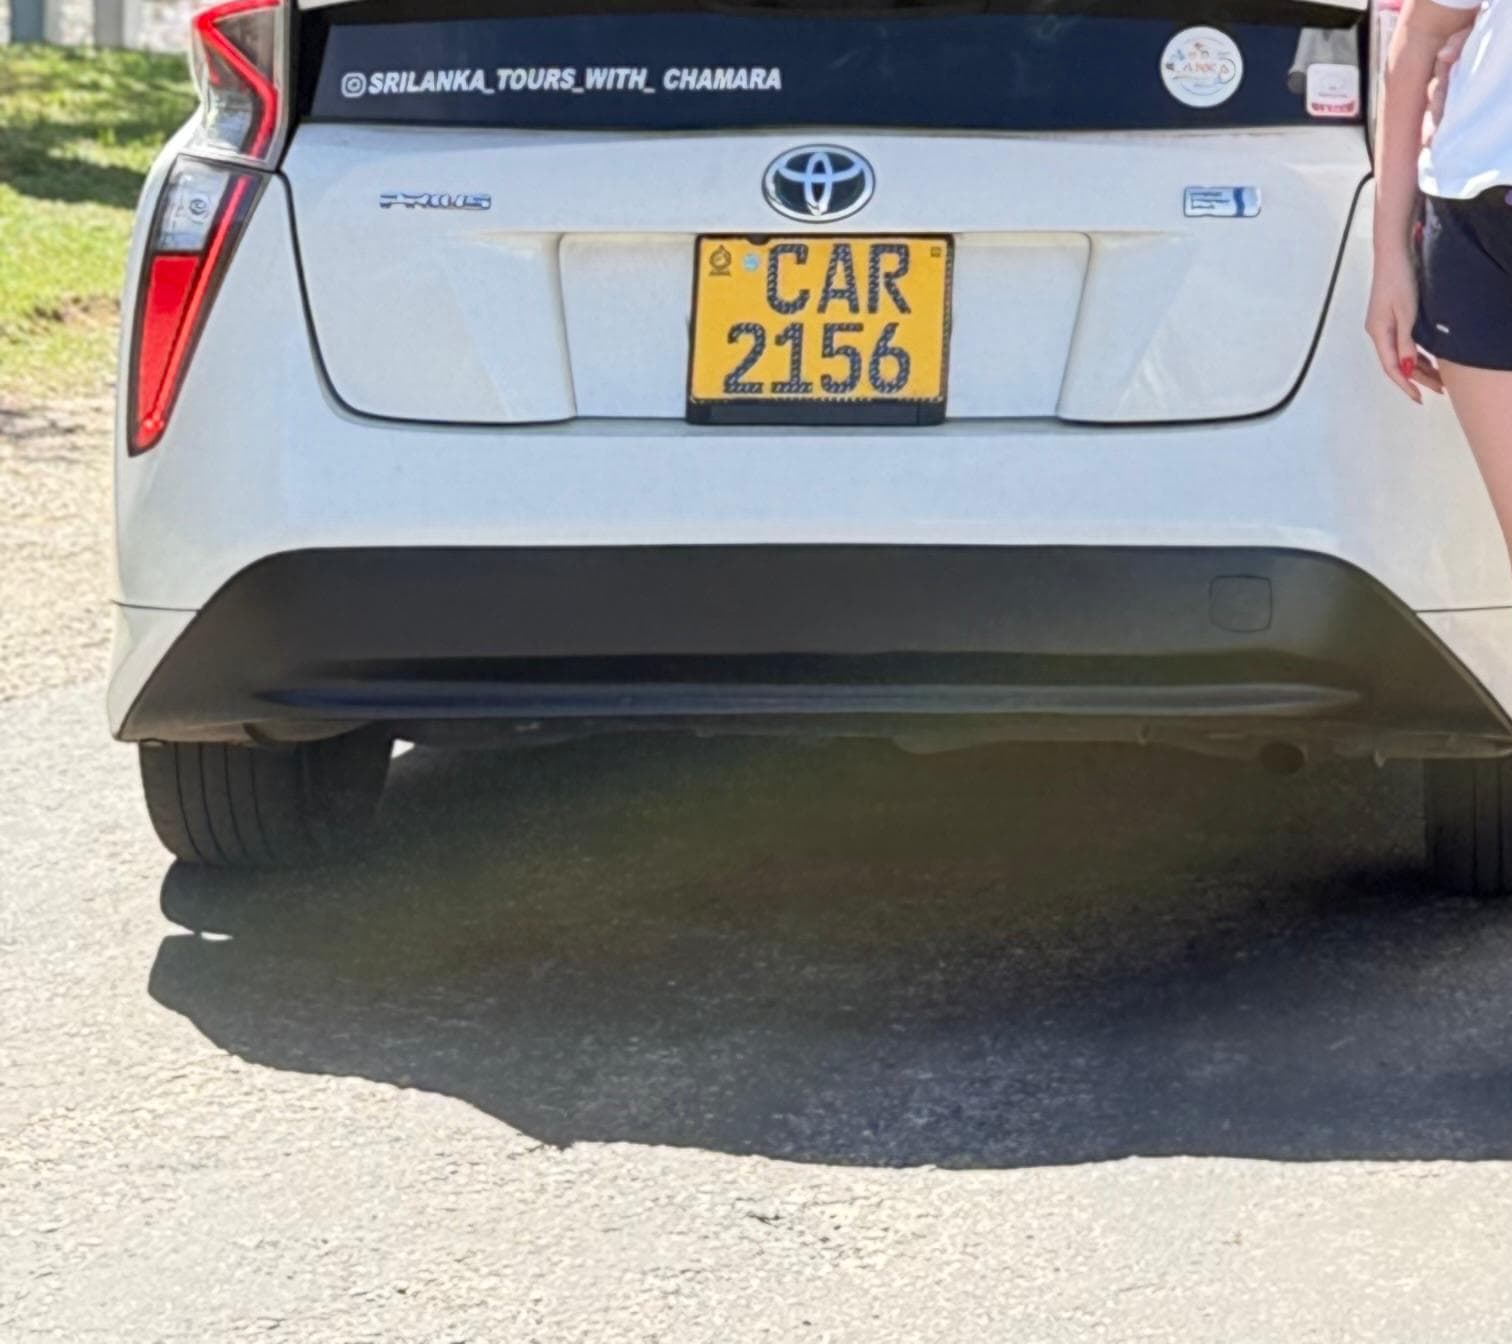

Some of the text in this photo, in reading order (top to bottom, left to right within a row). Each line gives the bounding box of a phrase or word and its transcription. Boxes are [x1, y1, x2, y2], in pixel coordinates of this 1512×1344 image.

[663, 67, 782, 91] CHAMARA
[766, 243, 912, 315] CAR
[722, 322, 911, 394] 2156
